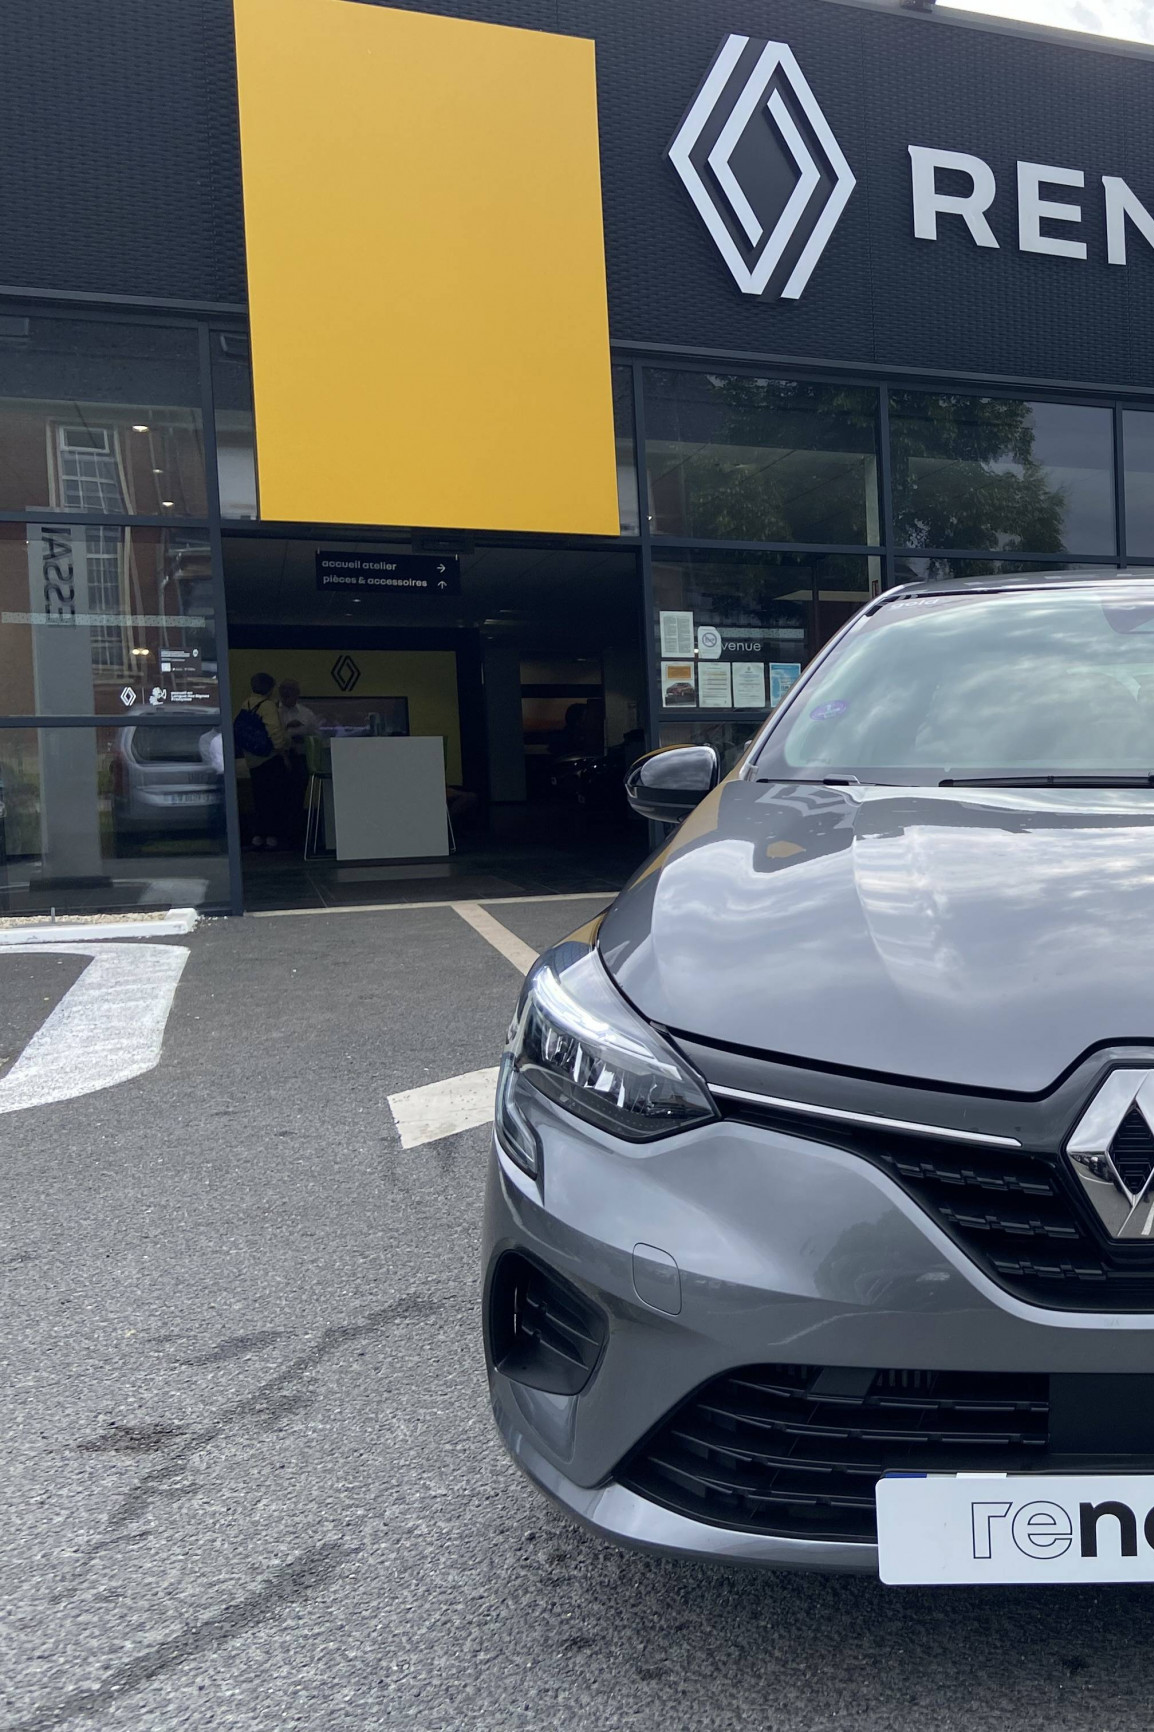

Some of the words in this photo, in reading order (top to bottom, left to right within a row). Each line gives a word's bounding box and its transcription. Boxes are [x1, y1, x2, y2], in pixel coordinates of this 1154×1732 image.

[321, 560, 361, 569] accueil
[362, 561, 397, 571] atelier
[323, 574, 357, 584] pièces
[358, 576, 366, 584] &
[367, 578, 428, 588] accessoires
[721, 640, 762, 652] venue
